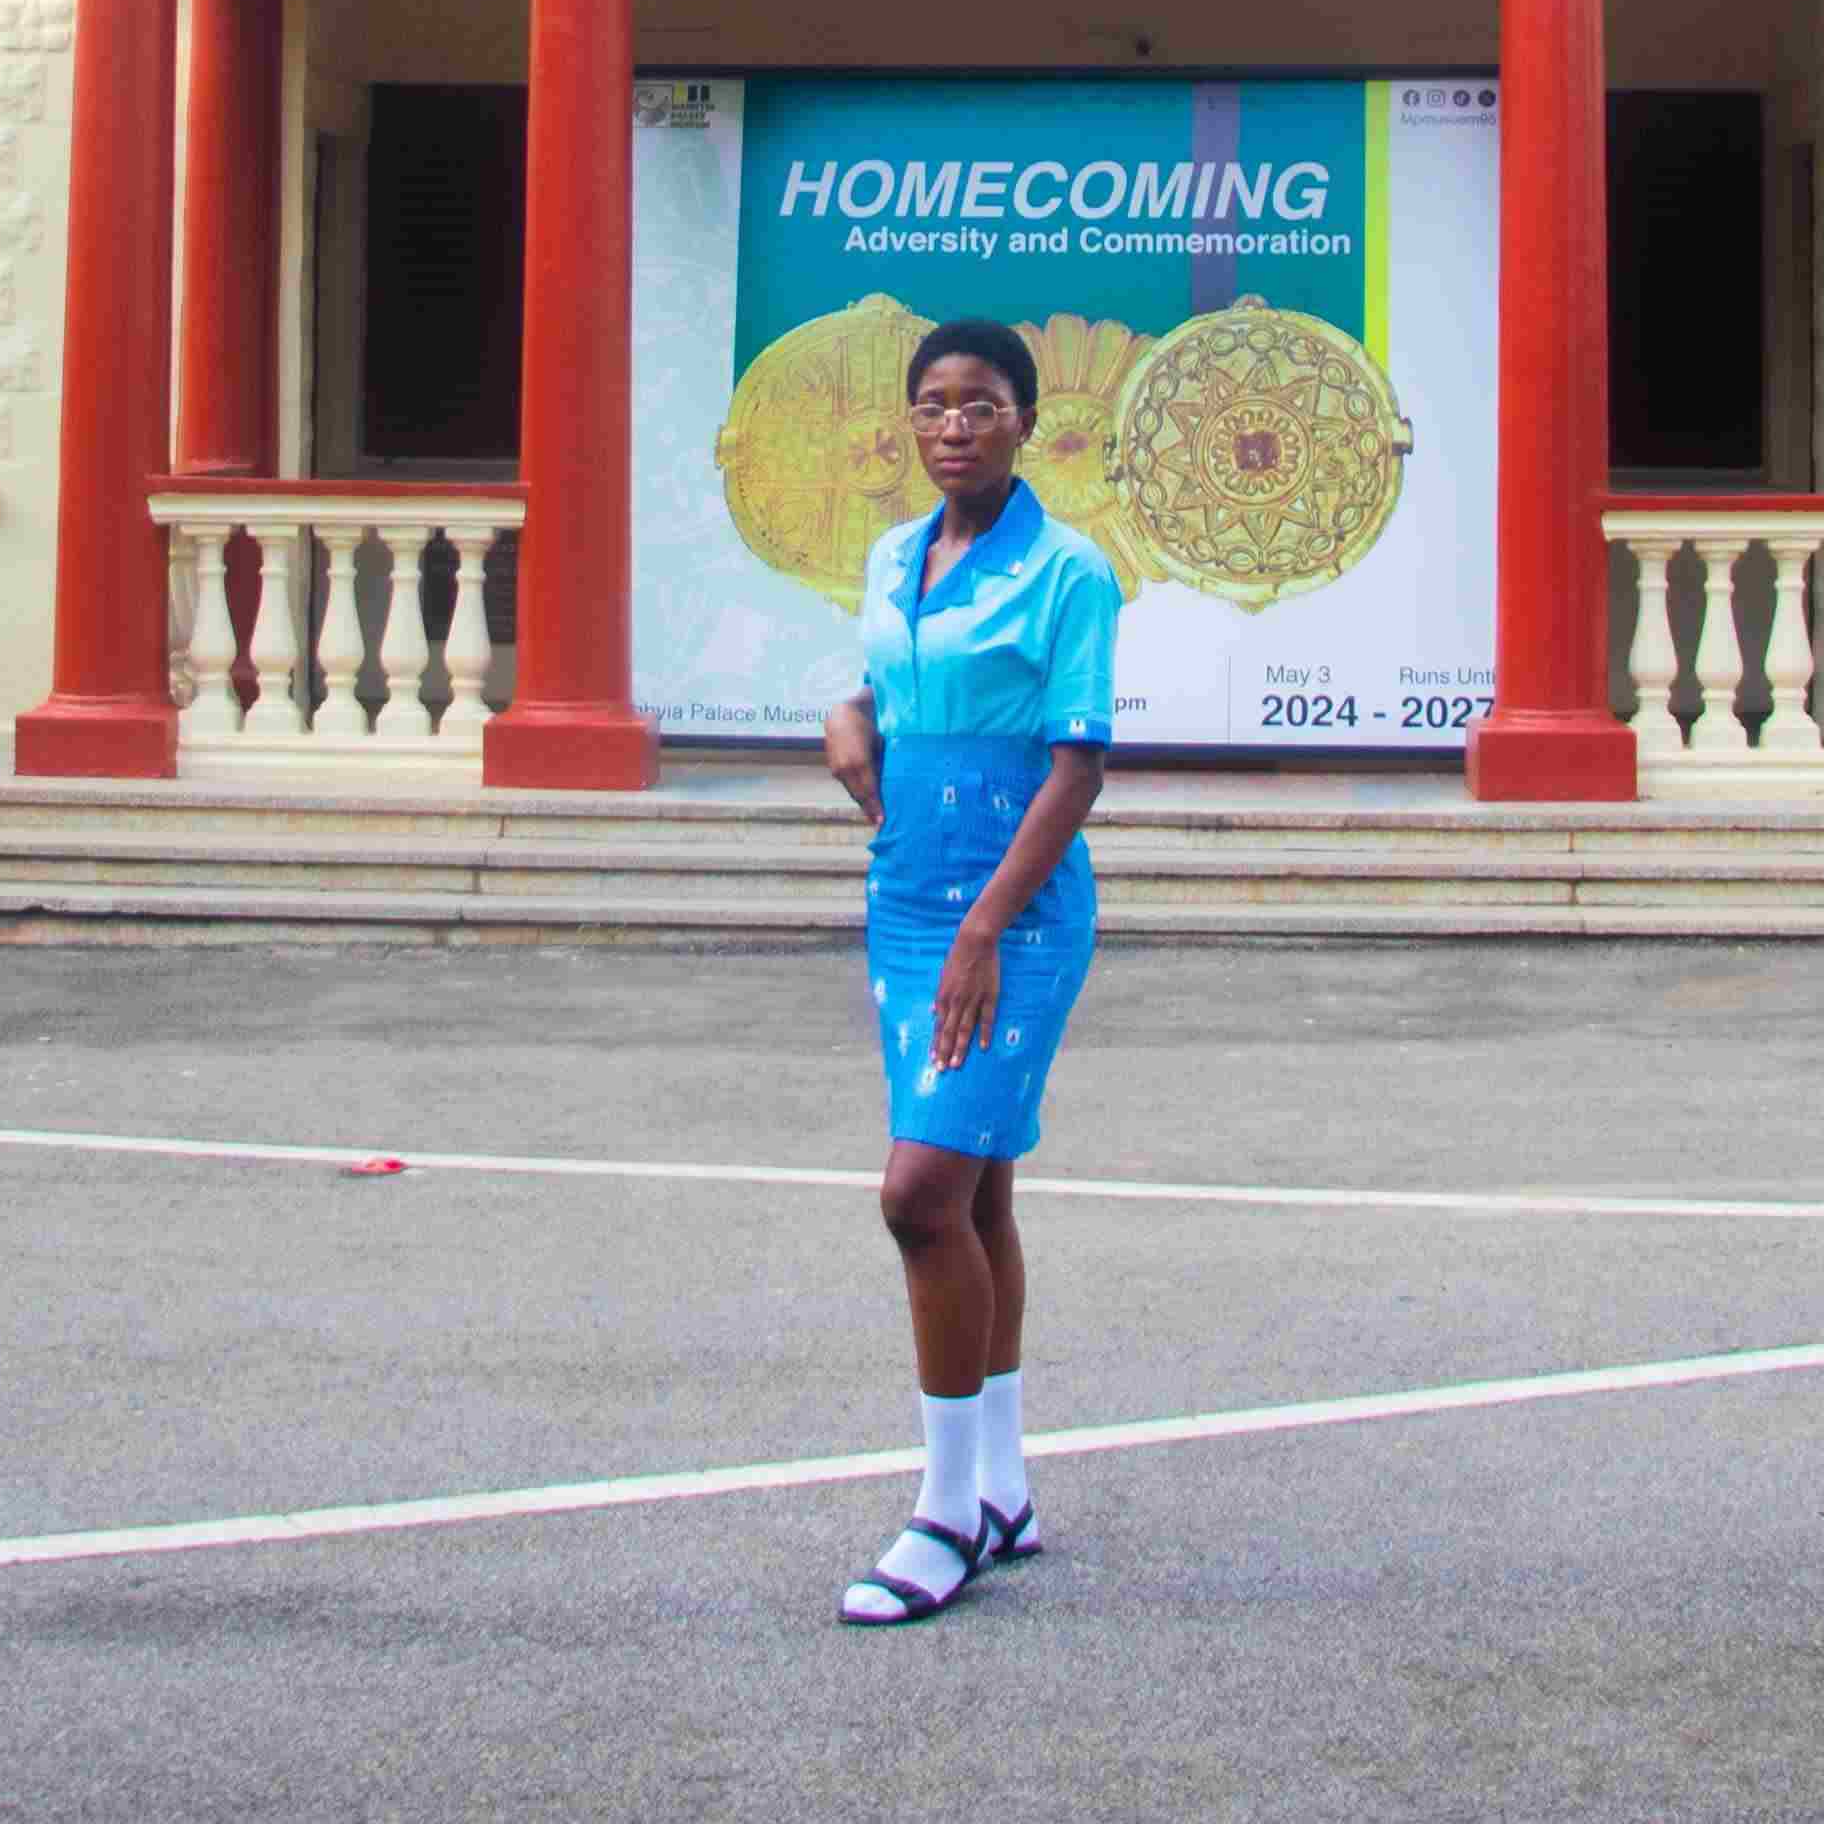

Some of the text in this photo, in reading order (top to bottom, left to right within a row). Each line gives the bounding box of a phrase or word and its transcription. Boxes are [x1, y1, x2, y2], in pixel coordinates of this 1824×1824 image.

[779, 159, 1330, 221] HOMECOMING
[844, 226, 1352, 259] Adversity and Commemoration
[1265, 664, 1331, 687] May 3
[1399, 665, 1497, 686] Runs Unti
[690, 702, 757, 722] Palace
[763, 703, 833, 723] Museu
[1114, 696, 1147, 715] pm
[1261, 694, 1495, 729] 2024 - 2027
